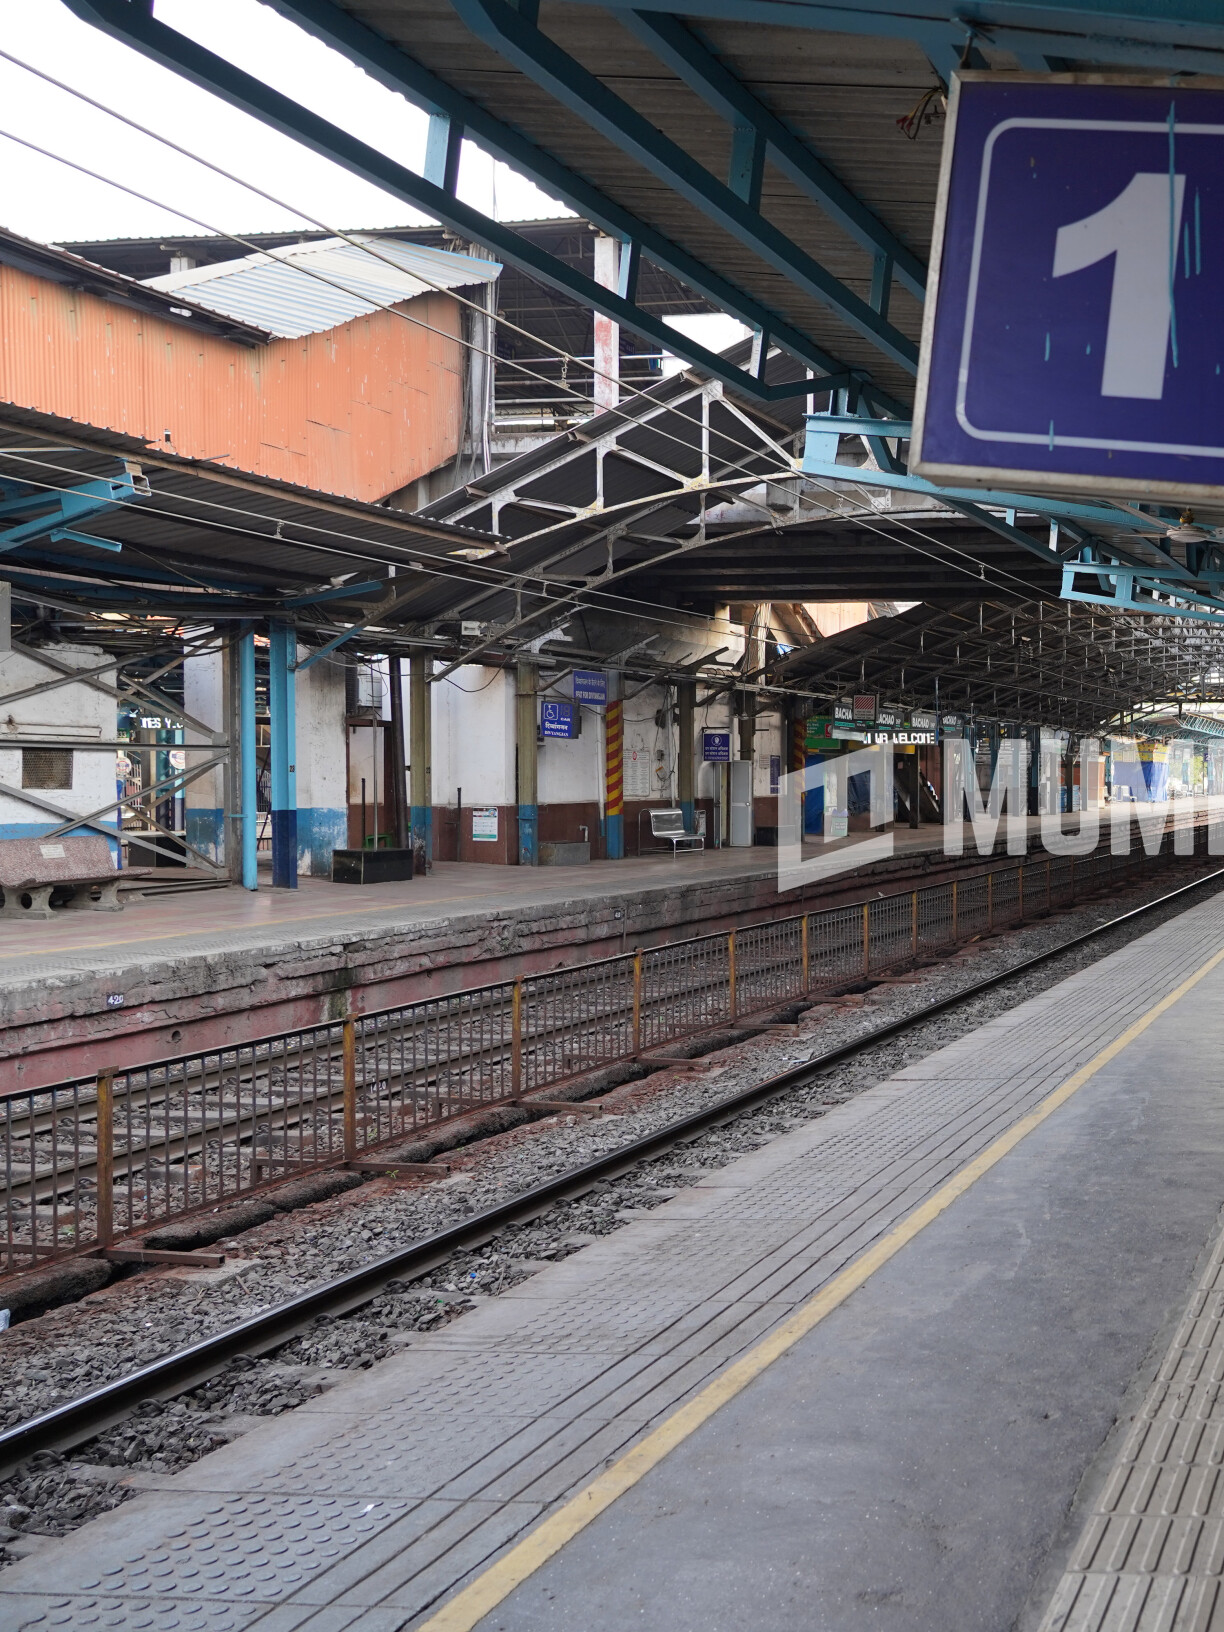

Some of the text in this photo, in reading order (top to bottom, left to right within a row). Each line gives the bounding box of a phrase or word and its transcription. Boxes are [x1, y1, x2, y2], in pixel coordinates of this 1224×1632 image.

[1052, 172, 1187, 400] 1
[834, 707, 853, 720] BACHA
[912, 717, 930, 728] BACHAO
[892, 732, 935, 744] WELCOME
